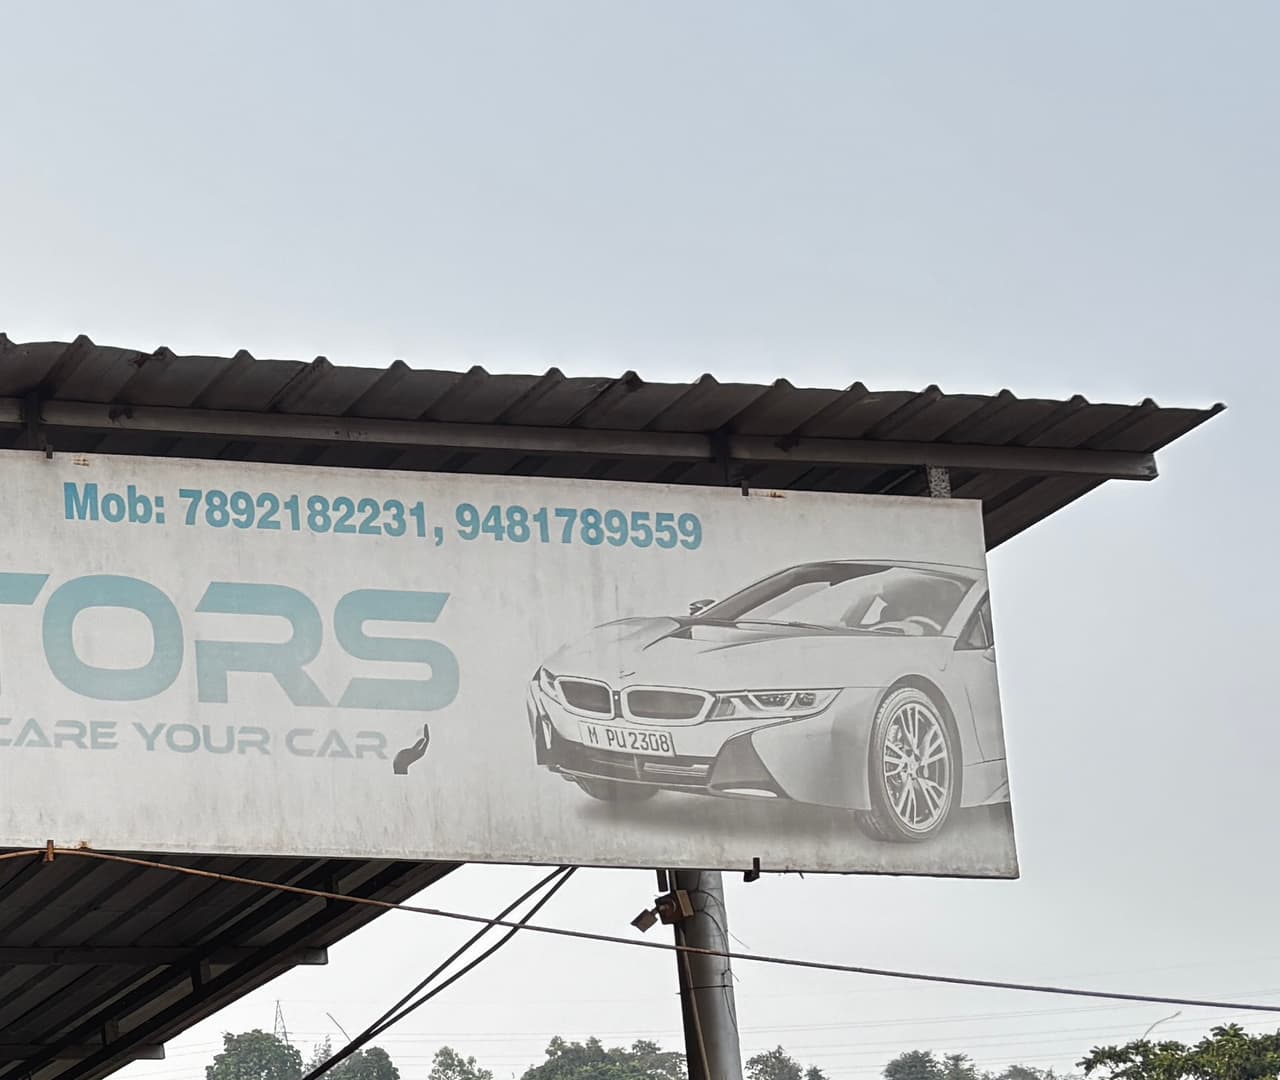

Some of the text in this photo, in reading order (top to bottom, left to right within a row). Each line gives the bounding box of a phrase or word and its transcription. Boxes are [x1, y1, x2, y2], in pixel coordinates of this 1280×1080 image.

[63, 481, 703, 550] Mob: 7892182231, 9481789559
[131, 722, 271, 756] YOUR
[285, 728, 389, 760] CAR
